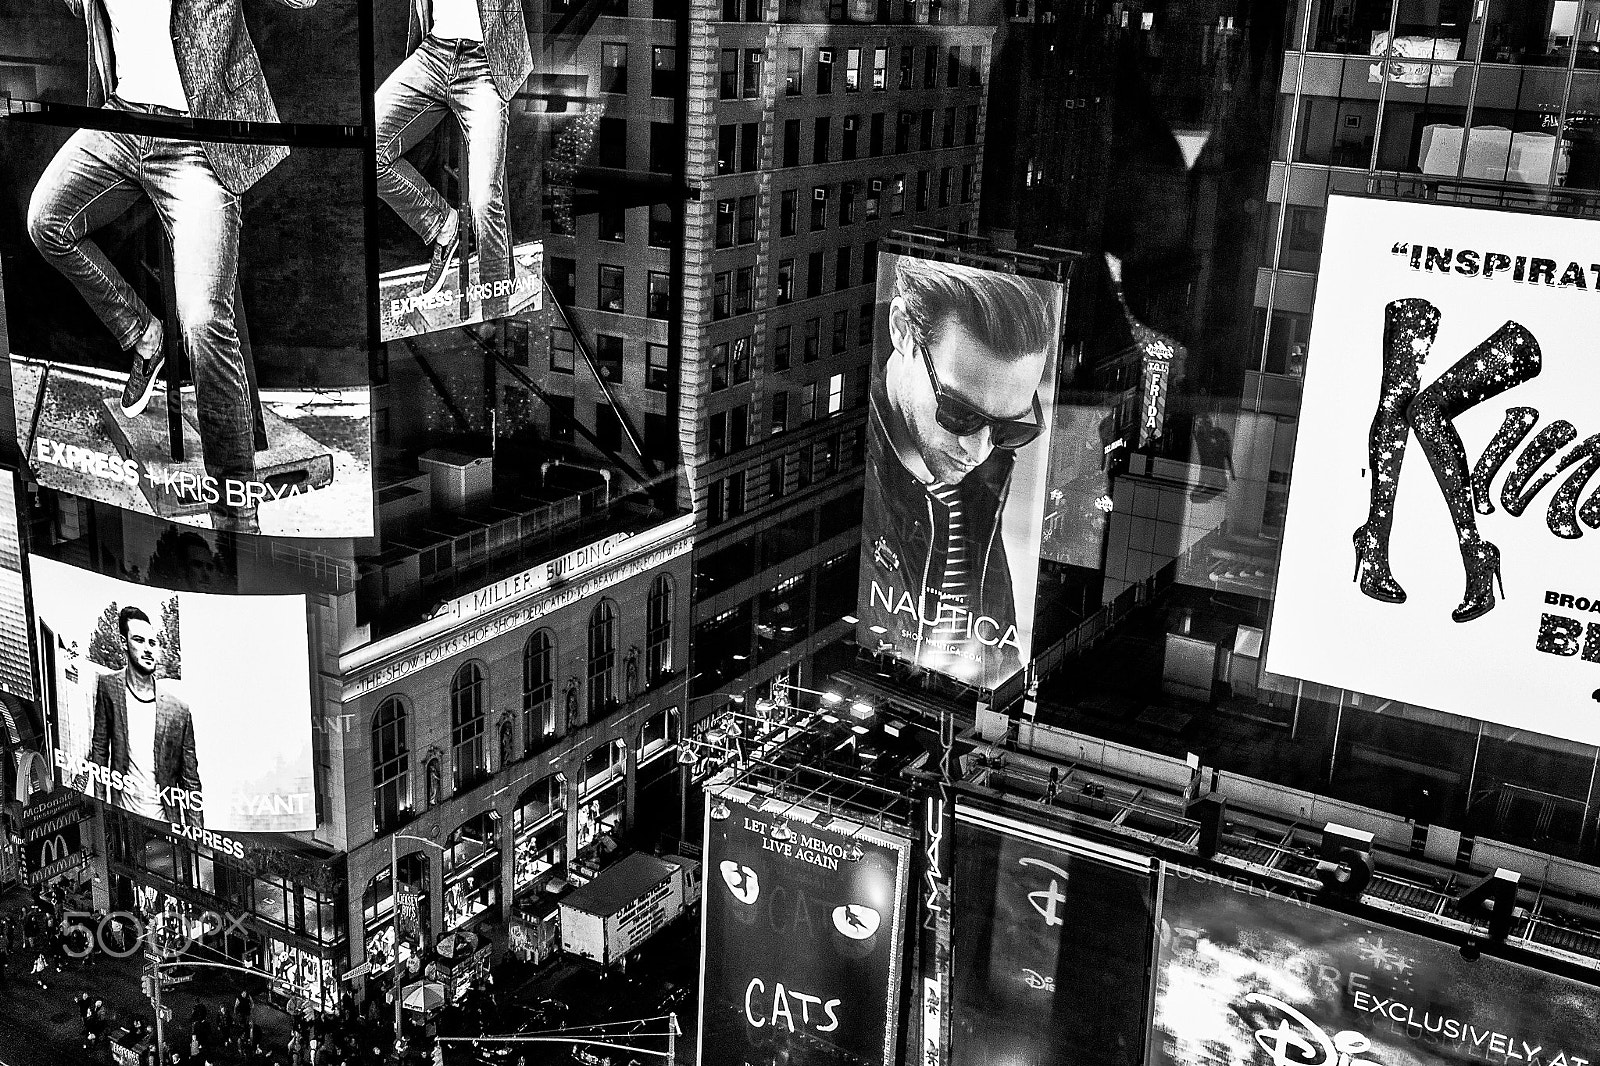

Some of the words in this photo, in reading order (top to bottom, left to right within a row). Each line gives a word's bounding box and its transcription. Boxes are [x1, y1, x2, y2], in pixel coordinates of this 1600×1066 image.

[390, 289, 453, 315] EXPRESS
[466, 283, 493, 303] KRIS
[493, 273, 538, 299] BRYANT
[37, 435, 139, 486] EXPRESS
[164, 467, 220, 504] KRIS
[473, 573, 533, 611] MILLER
[545, 540, 611, 583] BUILDING
[359, 672, 384, 692] THE
[386, 656, 420, 681] SHOW
[424, 639, 458, 664] FOLKS
[493, 612, 520, 634] SHOP
[522, 588, 574, 621] DEDICATED
[576, 583, 591, 598] TO
[869, 580, 1025, 657] NAUTICA
[901, 629, 924, 643] SHOP
[925, 637, 983, 664] NAUTICA.COM
[55, 747, 136, 796] EXPRESS
[155, 783, 205, 813] KRIS
[171, 822, 245, 860] EXPRESS
[744, 816, 768, 835] LET
[770, 824, 798, 845] TE
[762, 837, 793, 857] LIVE
[795, 847, 840, 871] AGAIN
[745, 977, 842, 1033] CATS
[1353, 990, 1542, 1062] EXCLUSIVELY
